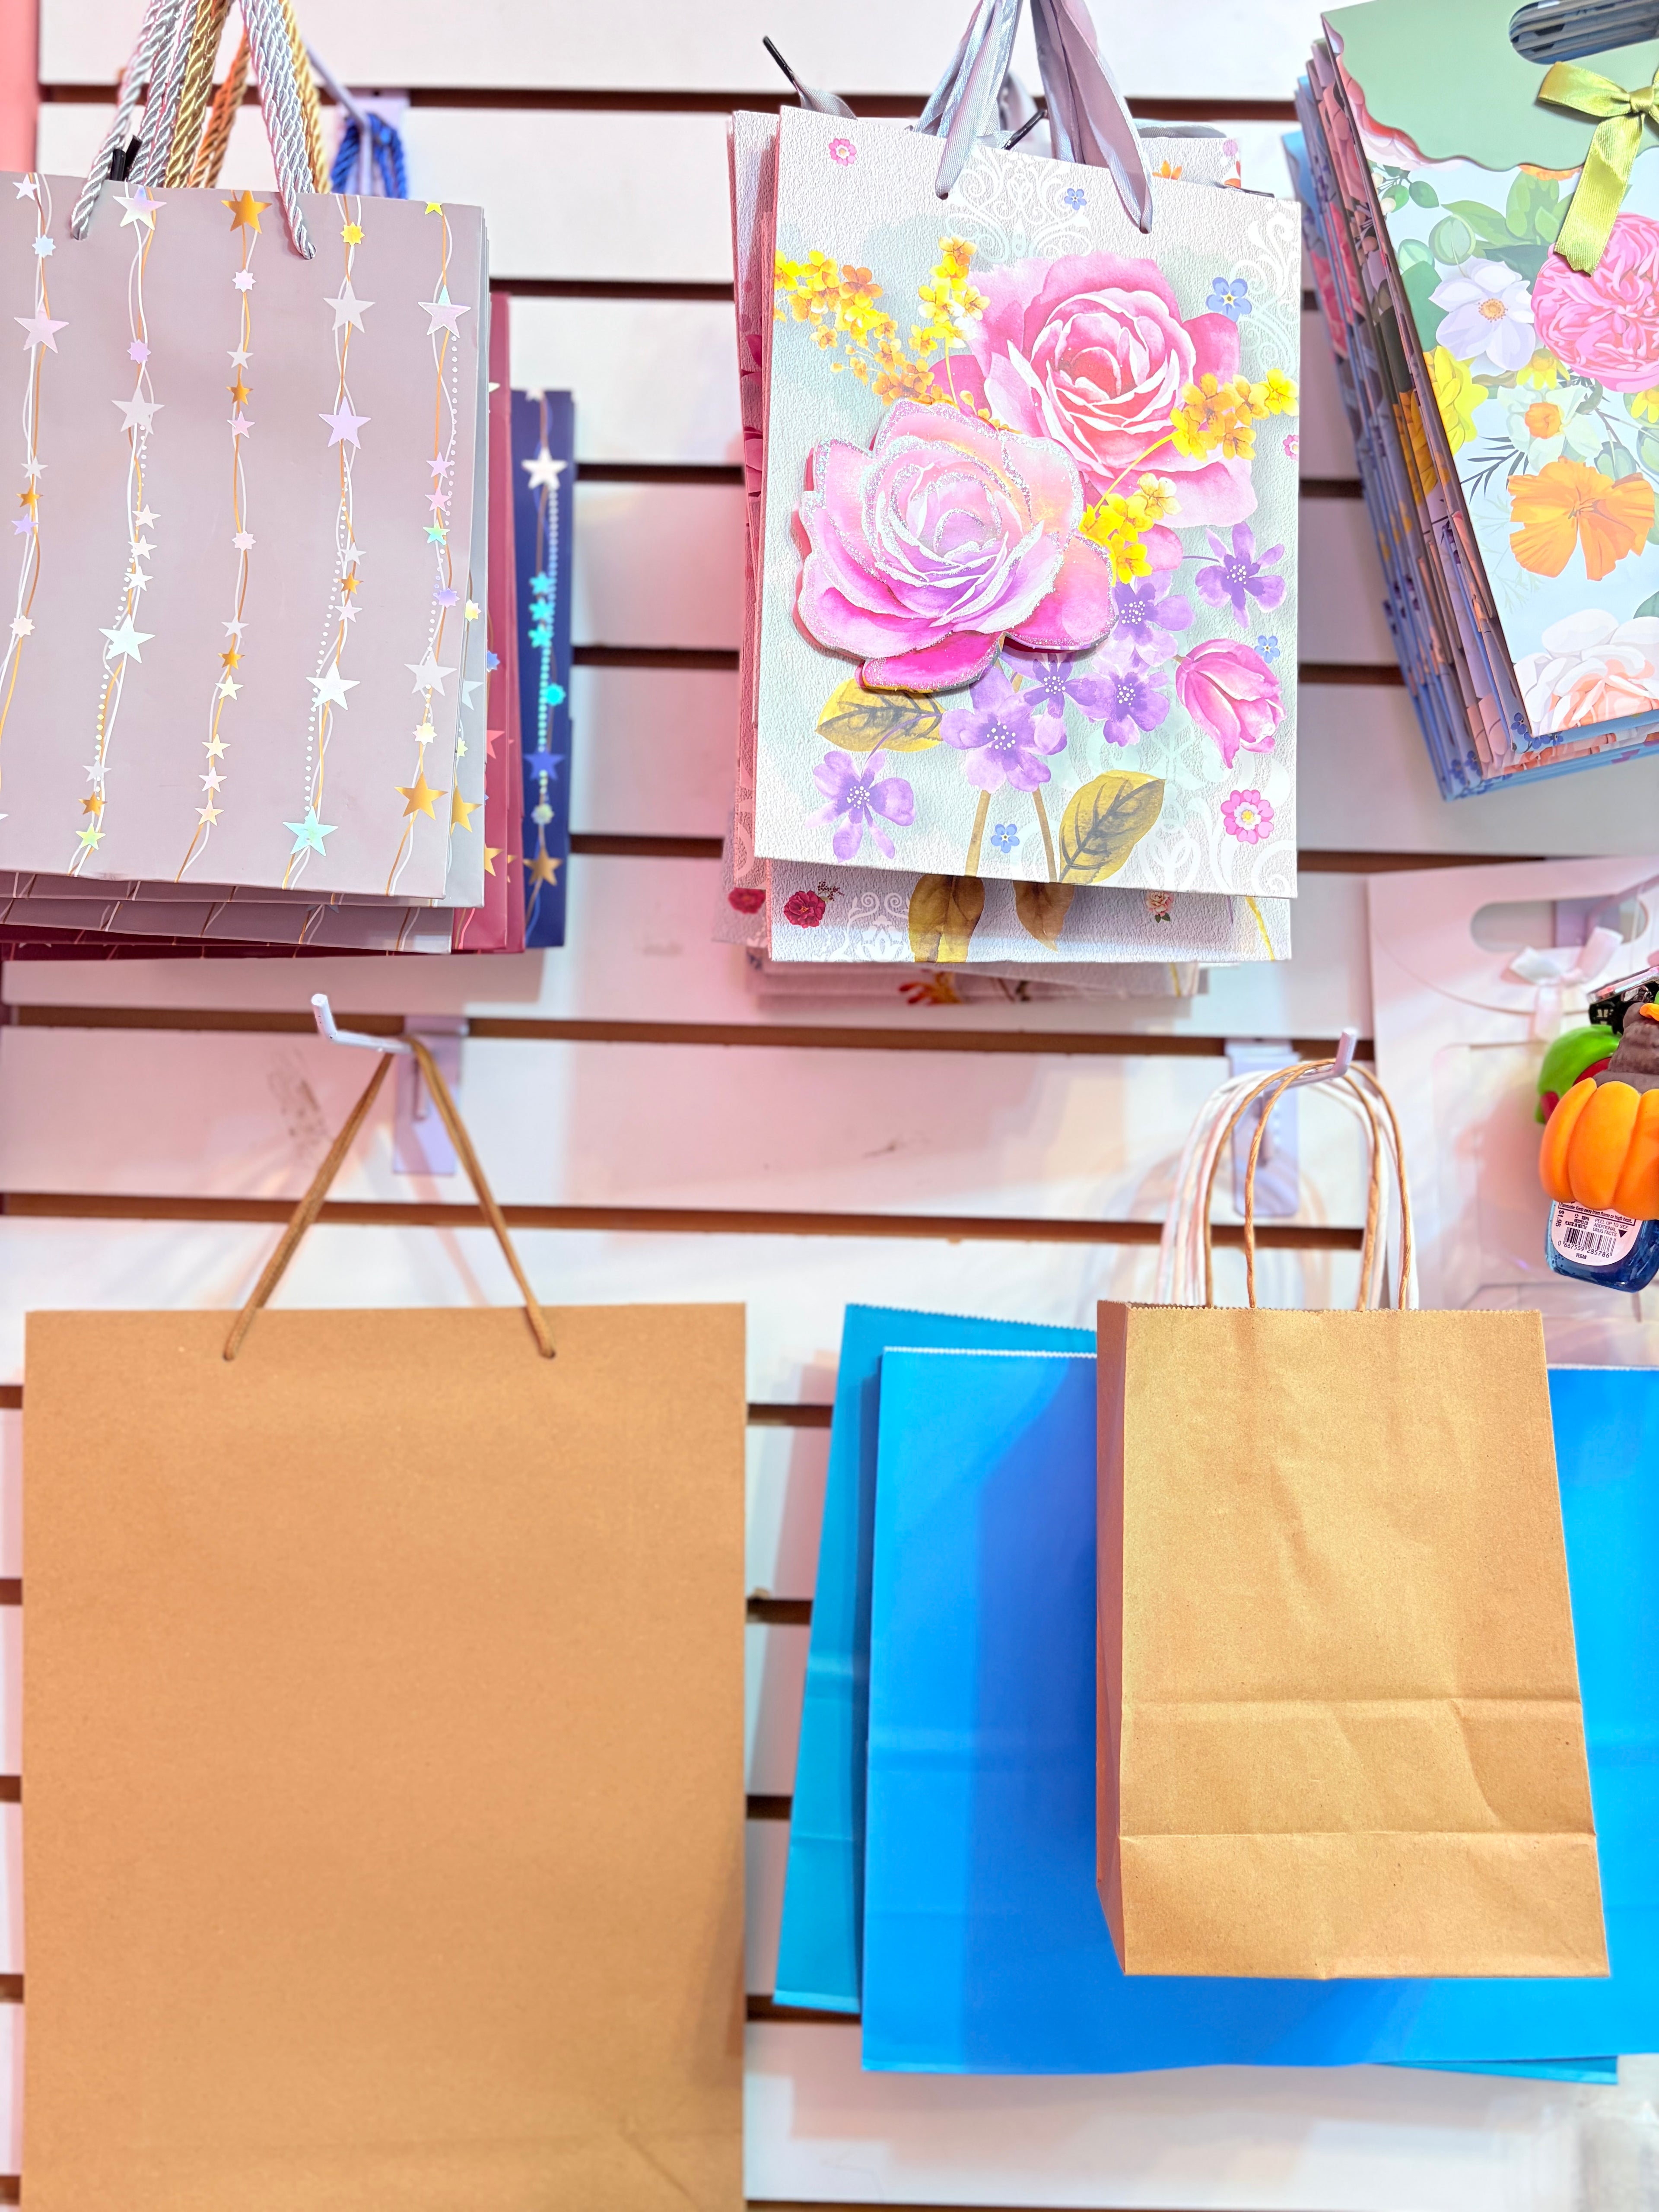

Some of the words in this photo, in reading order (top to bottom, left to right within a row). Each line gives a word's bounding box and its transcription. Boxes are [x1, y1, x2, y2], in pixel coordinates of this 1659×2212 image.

[1556, 1210, 1564, 1227] $1.95
[1593, 1223, 1616, 1232] ADDITIONAL
[1564, 1243, 1585, 1252] 667559
[1587, 1248, 1609, 1258] 285786
